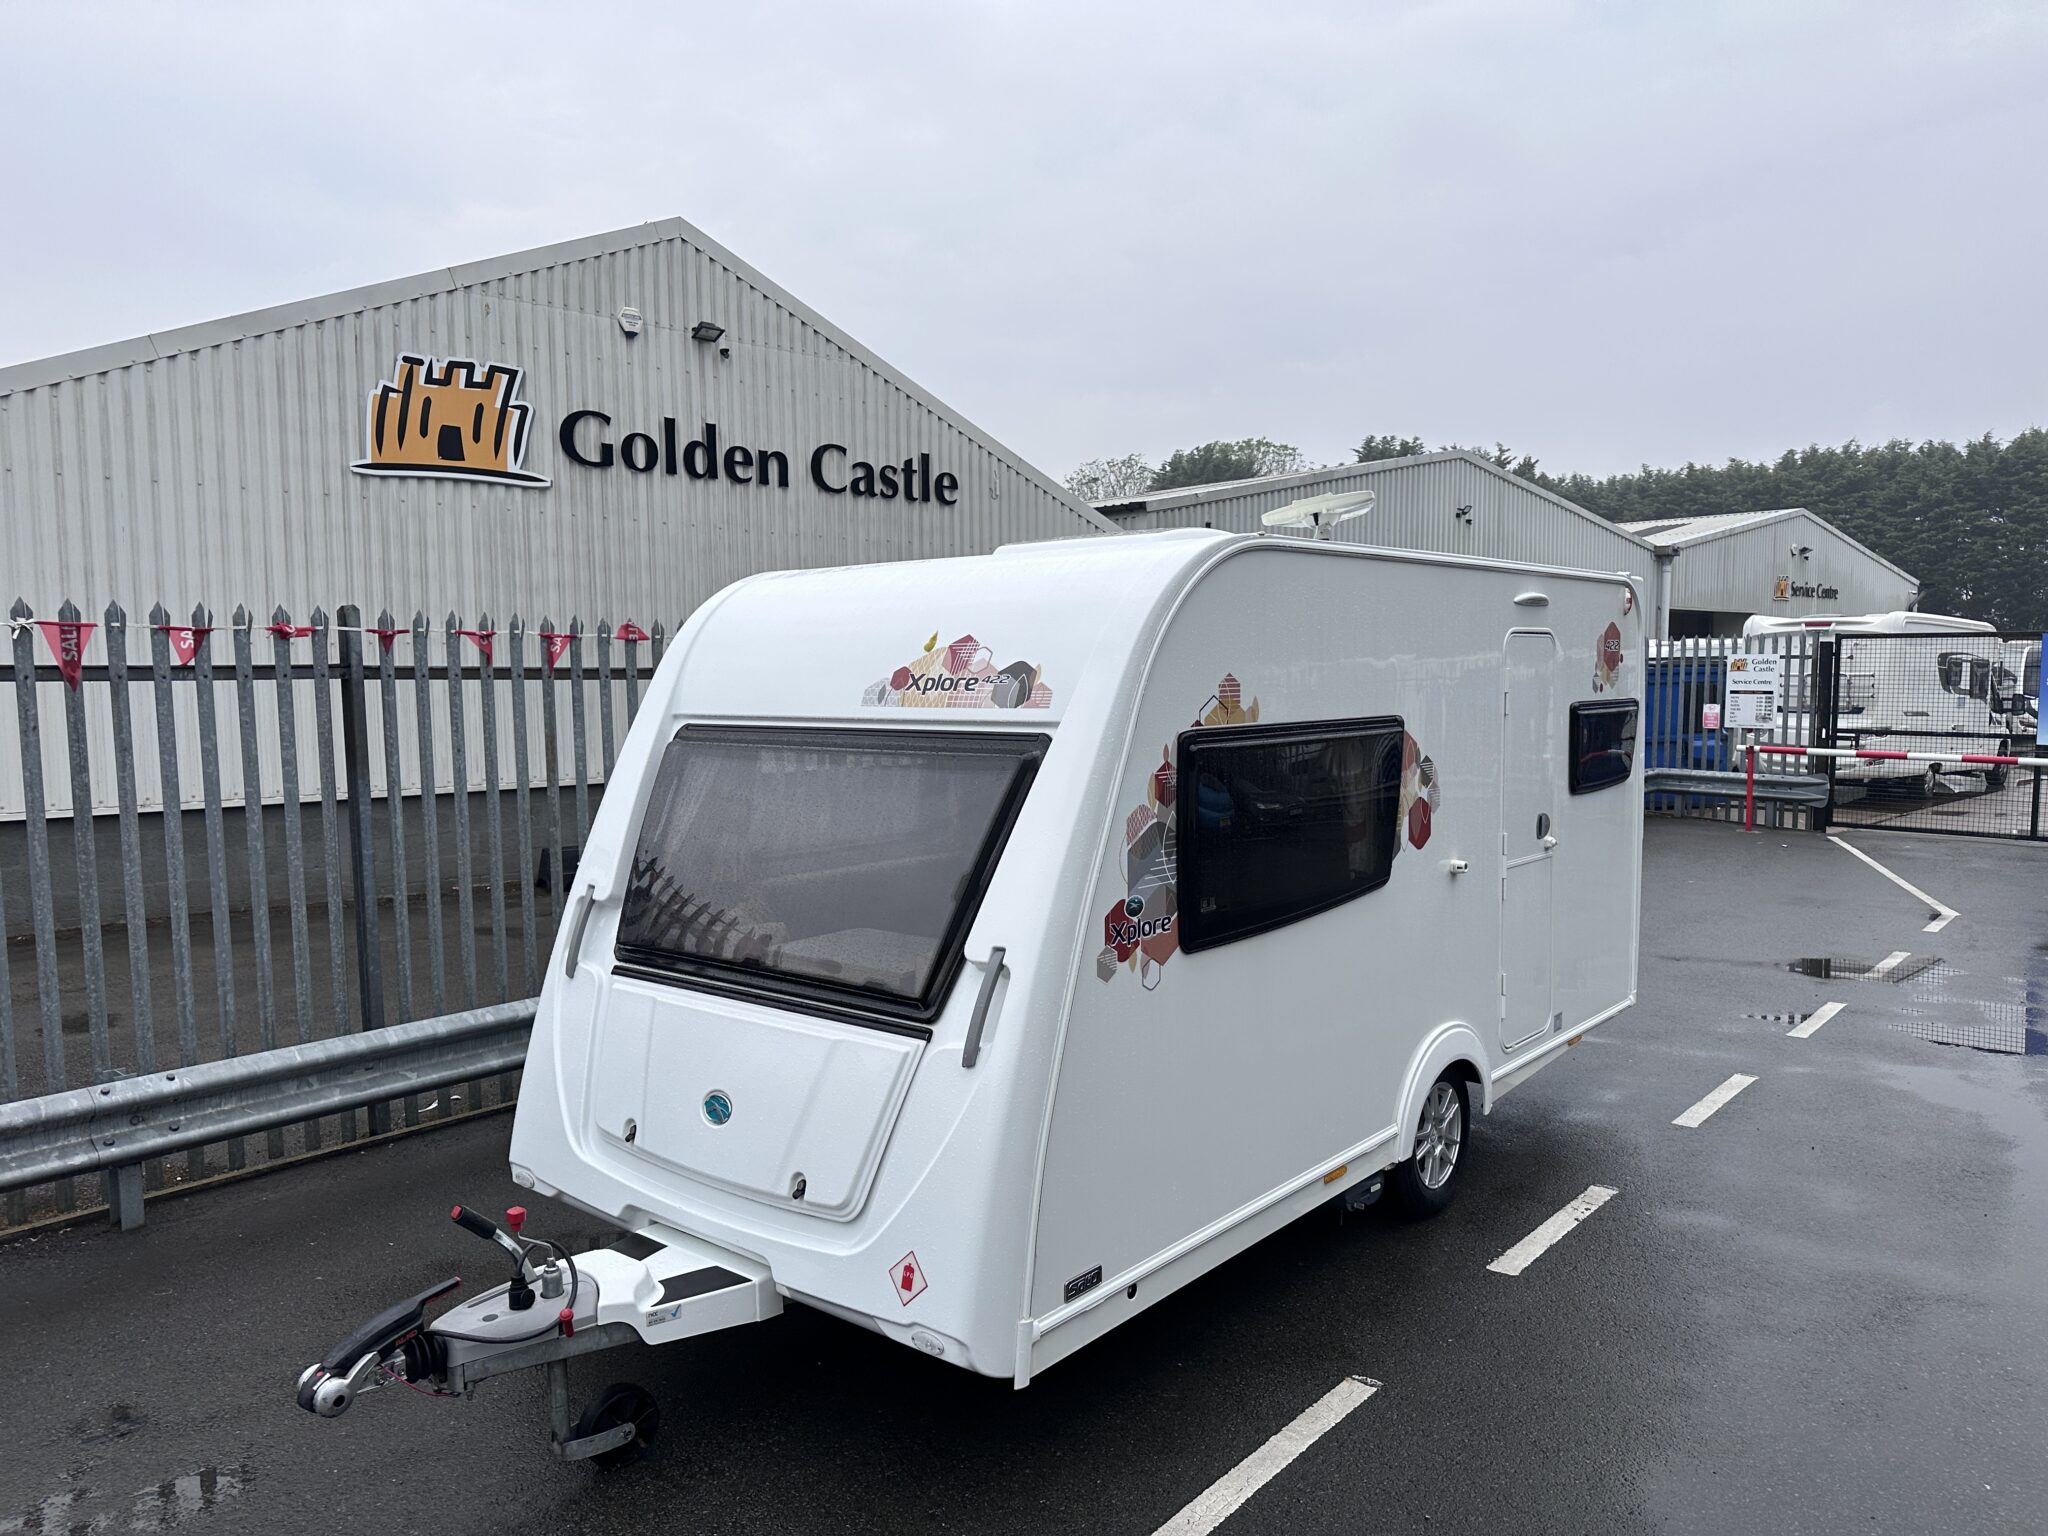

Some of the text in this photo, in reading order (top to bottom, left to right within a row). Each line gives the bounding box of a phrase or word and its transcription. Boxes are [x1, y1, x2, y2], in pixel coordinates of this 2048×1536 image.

[559, 410, 958, 506] Golden Castle
[1791, 581, 1838, 600] Service Centre
[1604, 640, 1620, 651] 422
[905, 673, 1010, 695] Xplore 422
[1111, 915, 1172, 947] Xplore
